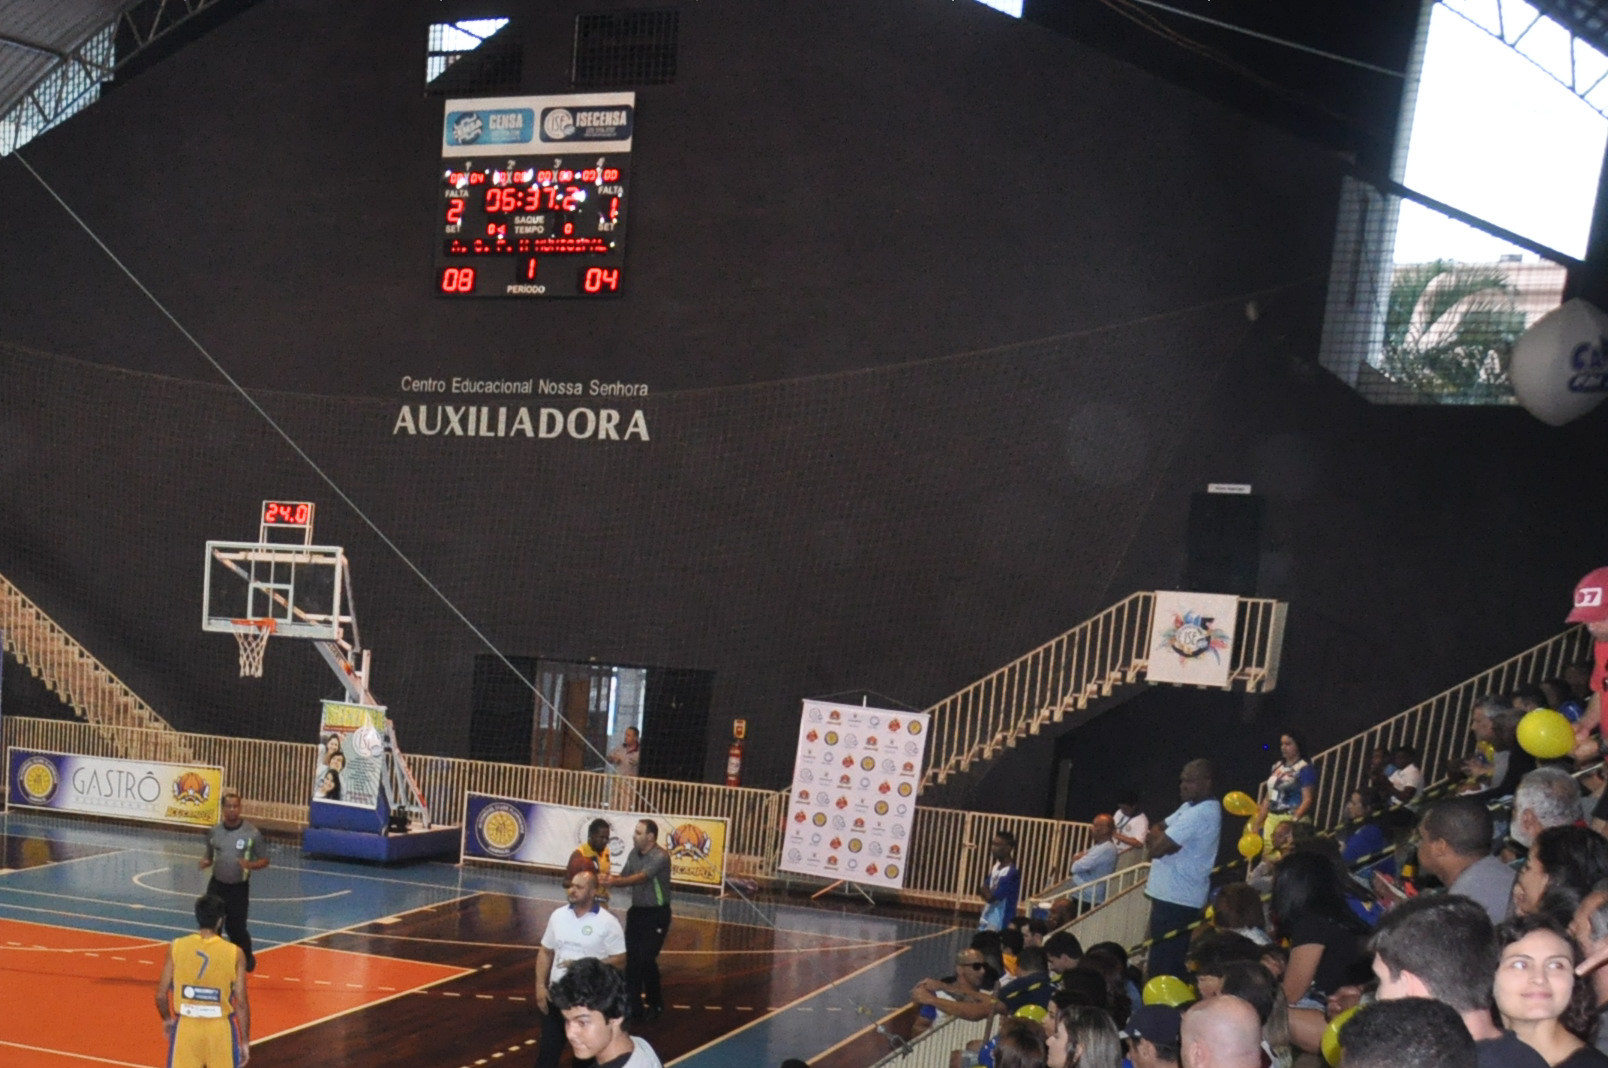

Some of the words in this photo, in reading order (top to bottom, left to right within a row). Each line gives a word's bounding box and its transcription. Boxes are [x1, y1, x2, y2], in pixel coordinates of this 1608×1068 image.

[489, 114, 523, 129] CENSA
[576, 110, 627, 127] ISECENSA
[445, 190, 469, 198] FALTA
[446, 199, 465, 223] 2
[514, 225, 545, 234] TEMPO
[527, 258, 537, 279] 1
[443, 267, 474, 292] 08
[584, 267, 619, 292] 04
[401, 376, 446, 393] Centro
[452, 377, 533, 394] Educacional
[538, 379, 583, 395] Nossa
[589, 380, 649, 397] Senhora
[393, 405, 651, 441] AUXILIADORA
[265, 503, 310, 524] 24.0
[72, 766, 161, 802] GASTRÔ
[196, 950, 210, 979] 7
